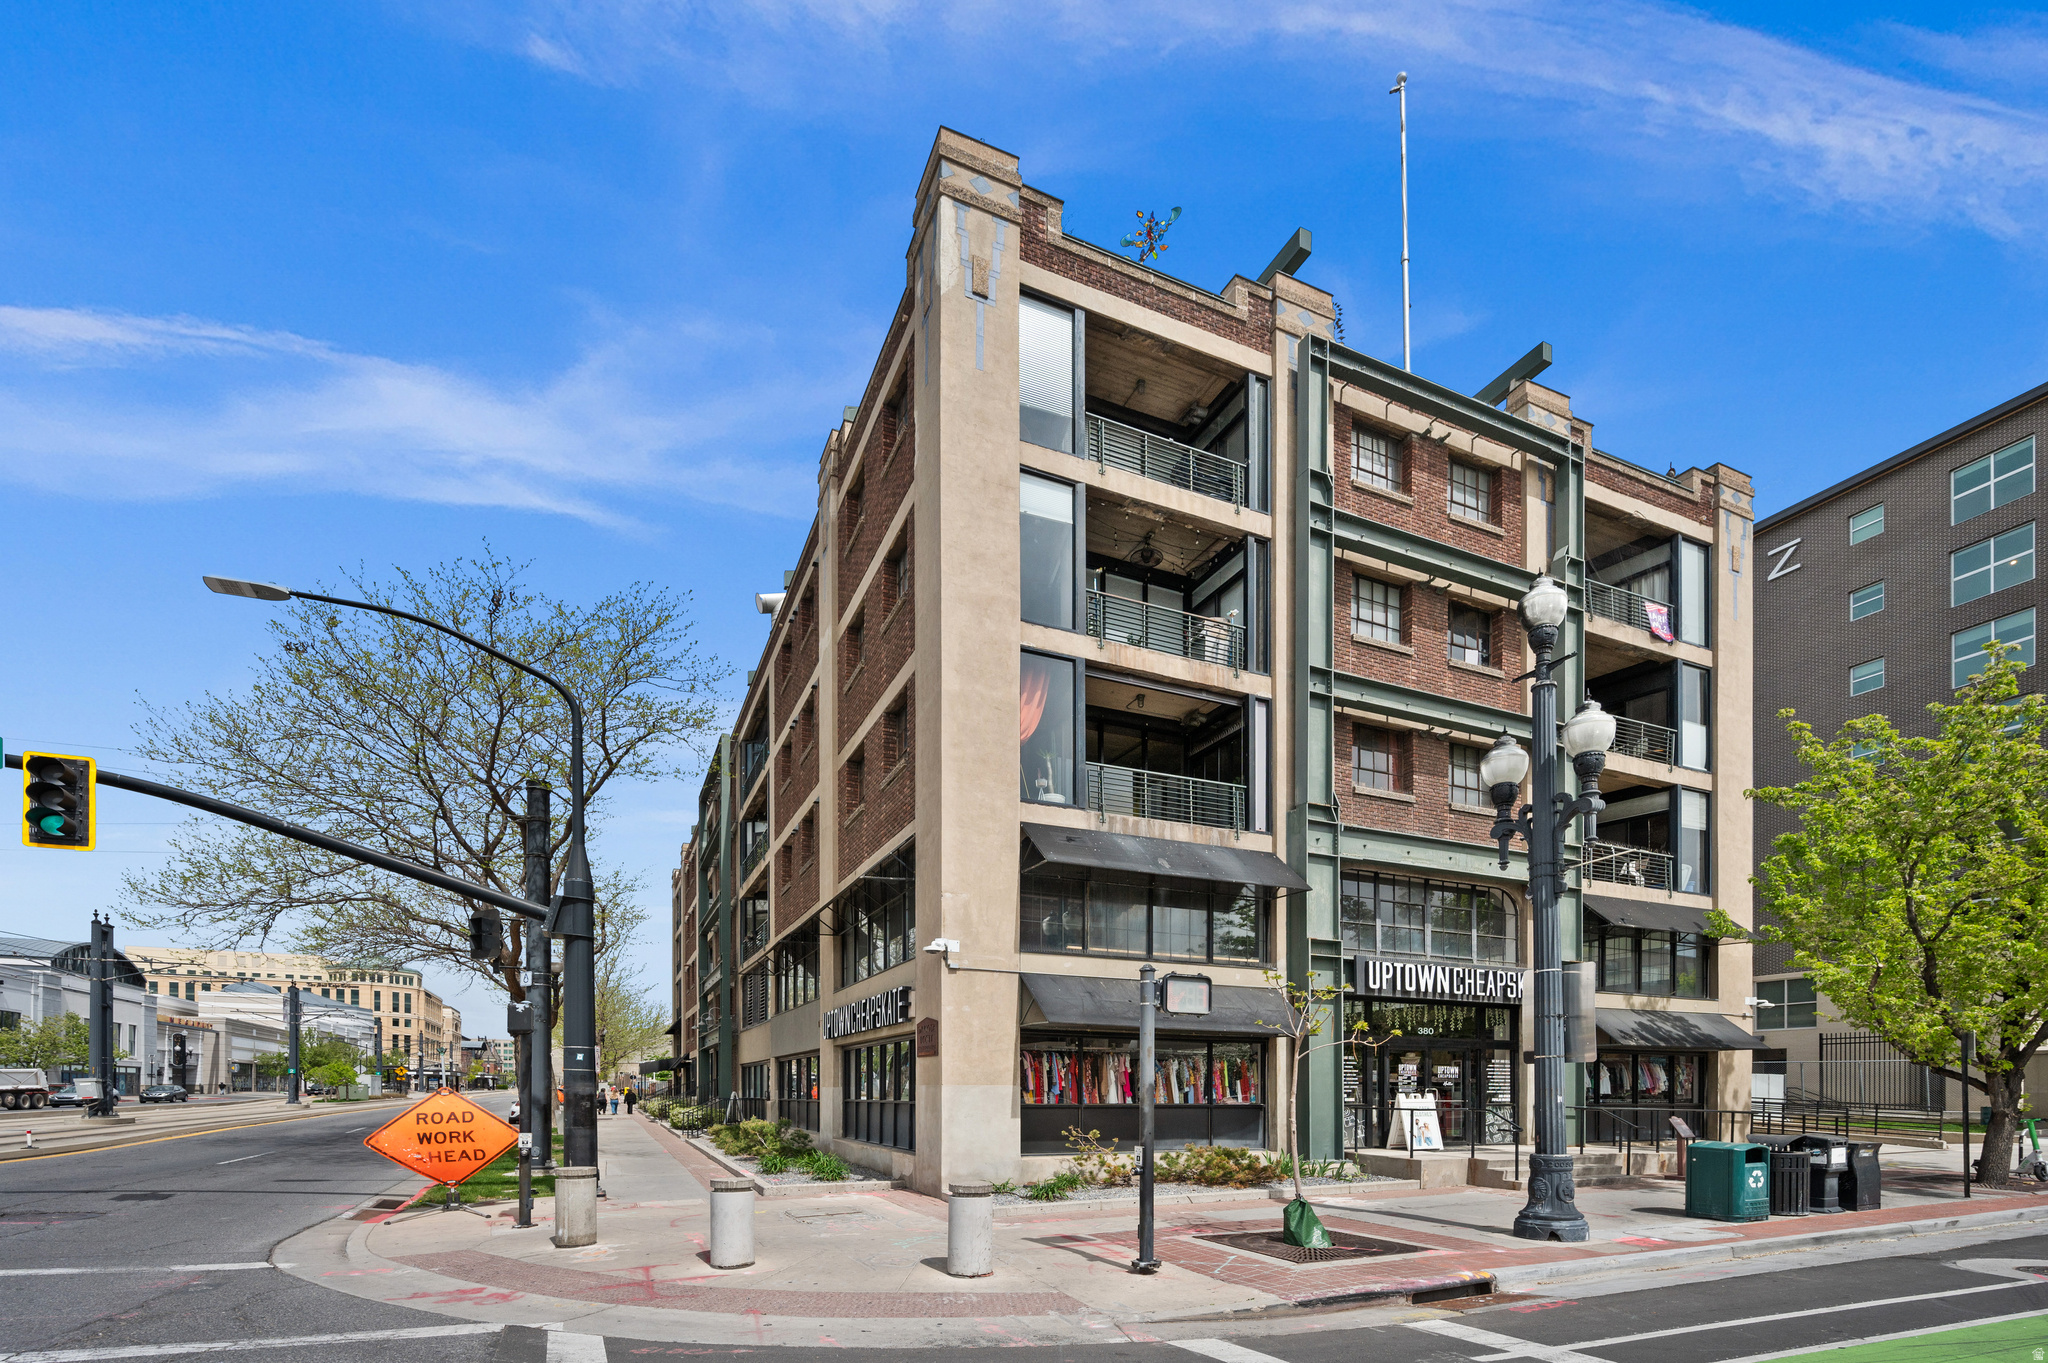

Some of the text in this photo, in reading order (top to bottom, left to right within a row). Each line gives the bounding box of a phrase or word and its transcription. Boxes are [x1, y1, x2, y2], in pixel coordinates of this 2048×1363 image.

[1368, 960, 1523, 998] UPTOWN CHEAPSK
[823, 986, 905, 1039] UPTOWN CHEAPSKATE
[1417, 1027, 1434, 1035] 380
[1437, 1066, 1459, 1074] UPTOWN
[416, 1111, 474, 1125] ROAD
[416, 1130, 475, 1145] WORK
[415, 1148, 486, 1163] AHEAD
